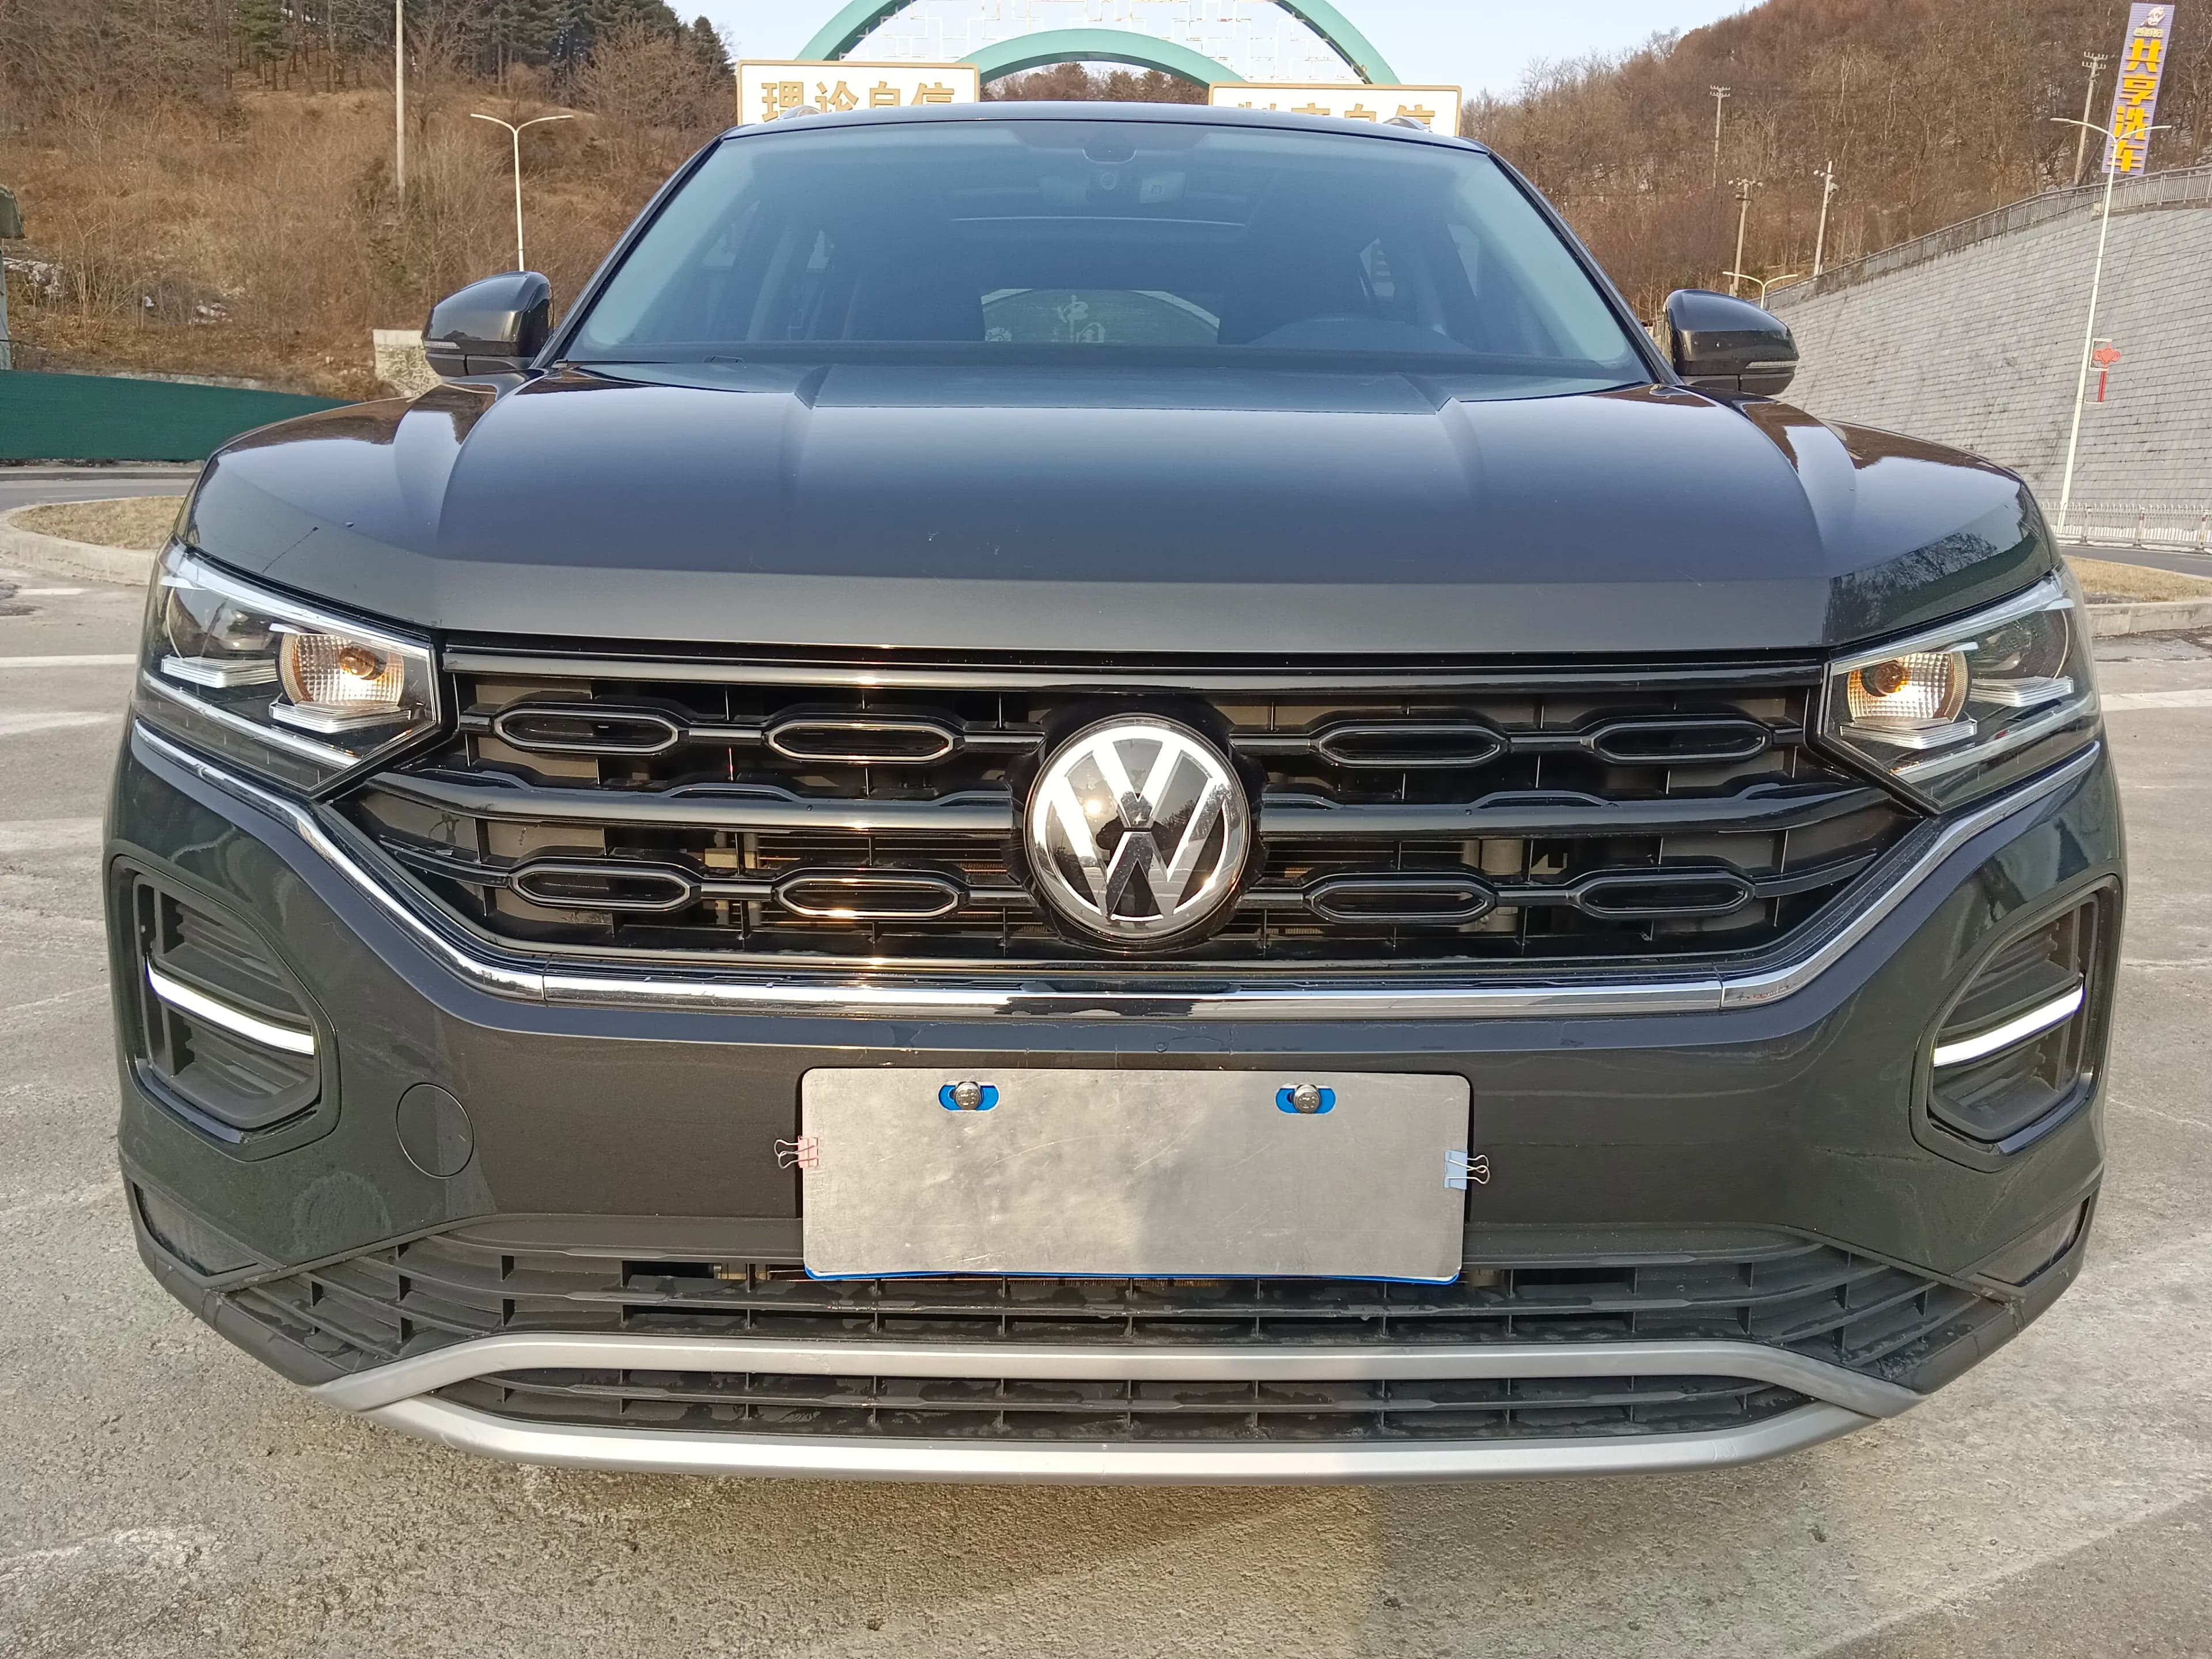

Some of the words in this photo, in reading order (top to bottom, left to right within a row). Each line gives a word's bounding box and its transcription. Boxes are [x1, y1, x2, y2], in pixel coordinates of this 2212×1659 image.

[2107, 38, 2164, 172] 共享洗车
[1033, 725, 1247, 935] VW
